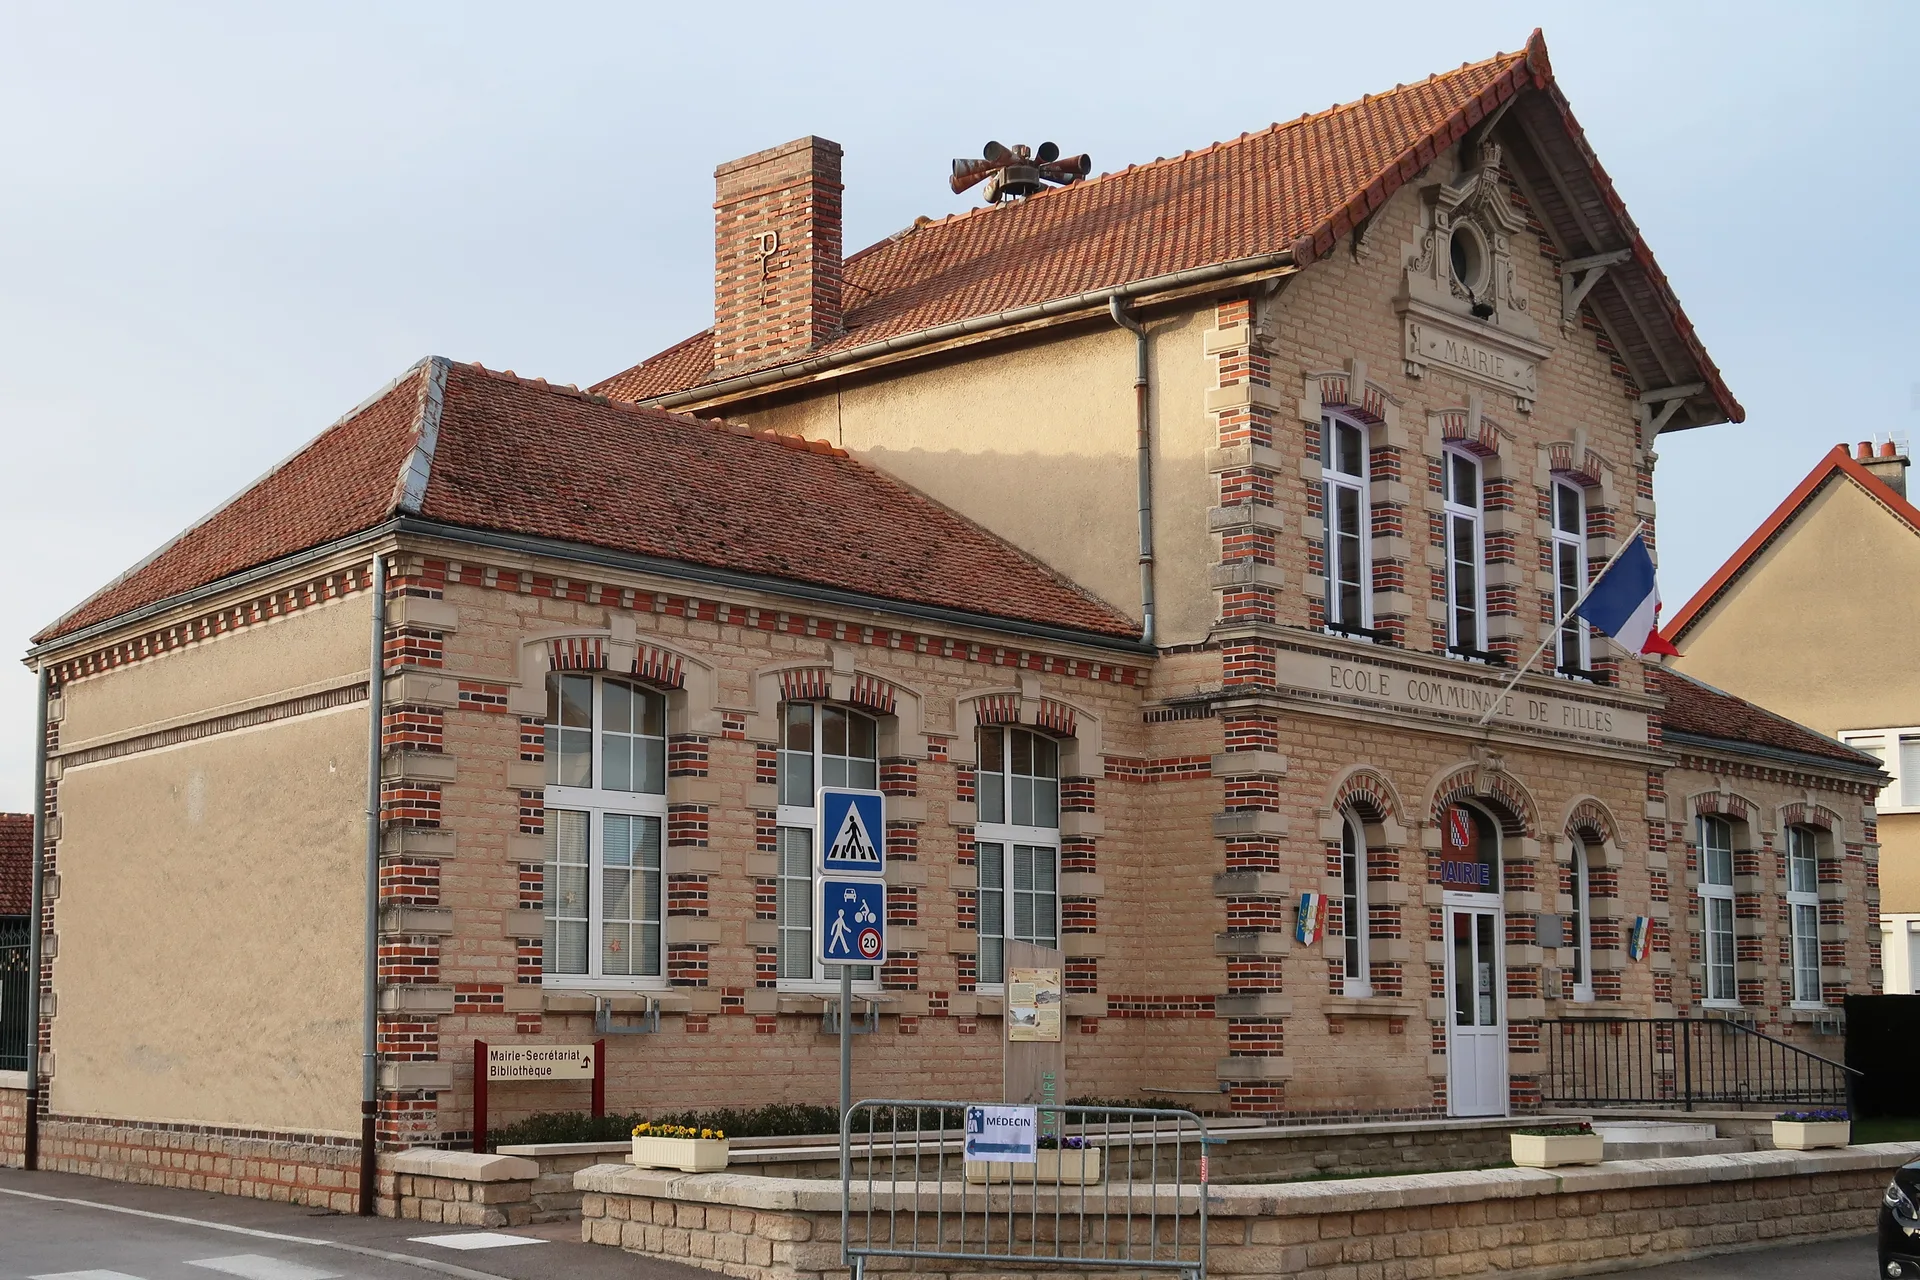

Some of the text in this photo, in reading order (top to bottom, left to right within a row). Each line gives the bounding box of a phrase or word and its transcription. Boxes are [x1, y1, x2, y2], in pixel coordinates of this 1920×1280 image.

[1444, 340, 1504, 378] MAIRIE
[1330, 665, 1613, 733] ECOLE COMMUNALE DE FILLES
[864, 937, 876, 948] 20
[490, 1050, 580, 1061] Mairie-Secrétariat
[490, 1065, 552, 1078] Bibliothèque
[986, 1115, 1031, 1127] MÉDECIN
